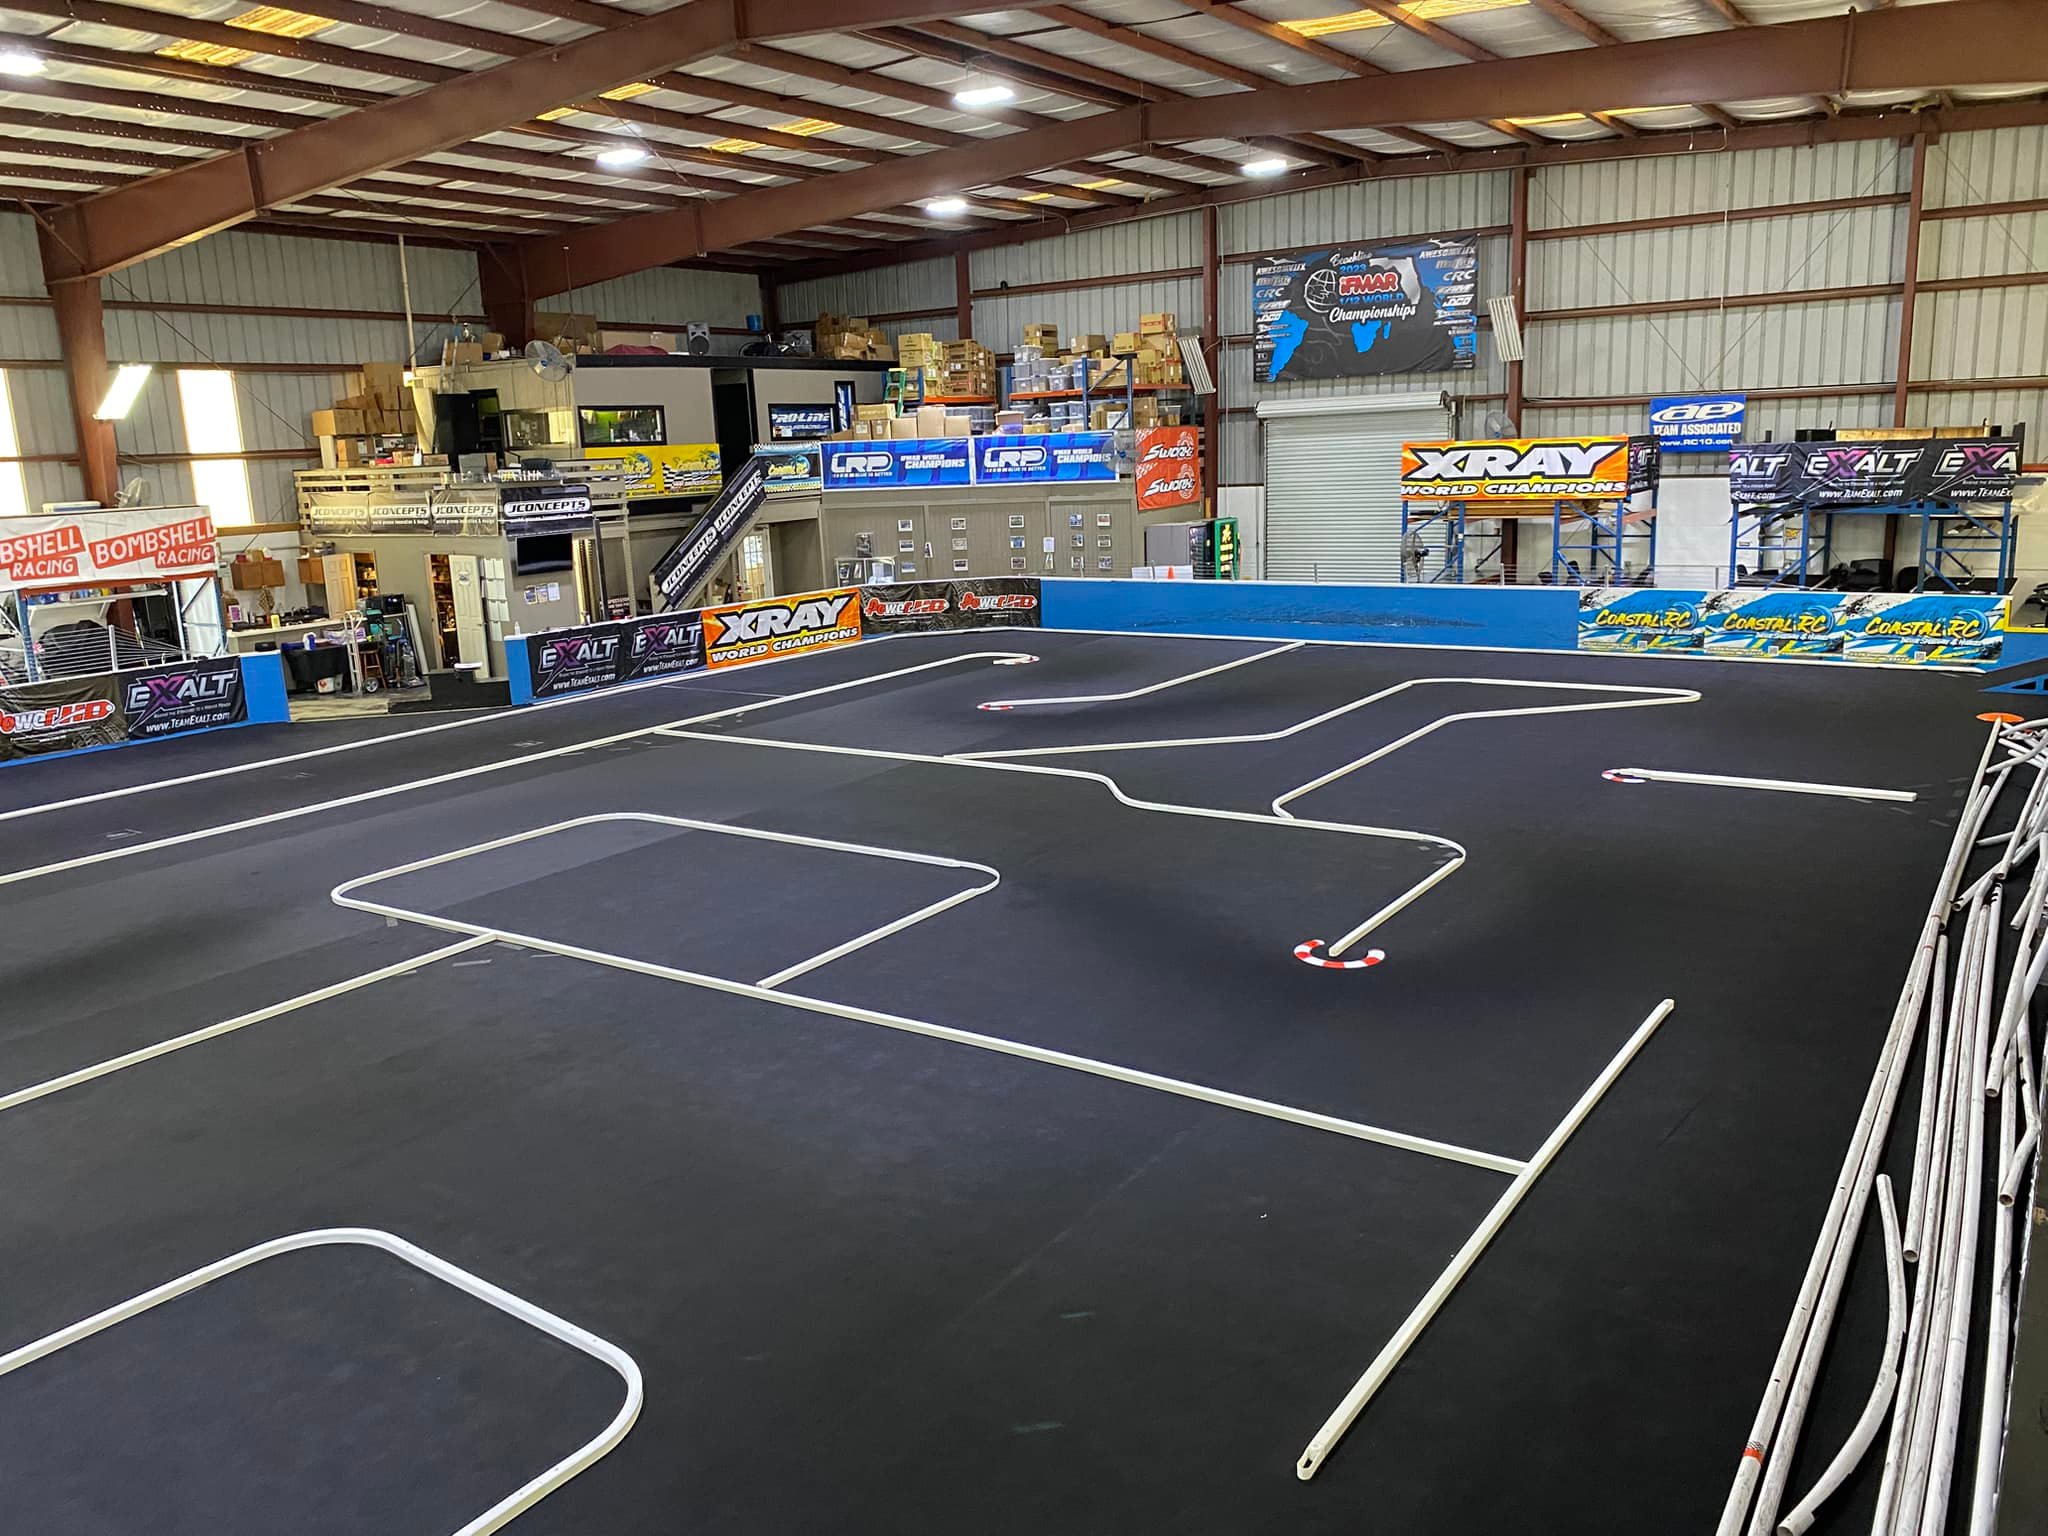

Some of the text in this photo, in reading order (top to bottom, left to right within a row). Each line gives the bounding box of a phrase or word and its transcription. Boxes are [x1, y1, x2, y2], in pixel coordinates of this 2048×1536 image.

[1340, 264, 1367, 273] 2023
[1443, 270, 1476, 281] CRC
[1256, 288, 1285, 298] CRC
[1340, 292, 1405, 305] 1/12 WORLD
[1329, 304, 1416, 323] Championships
[1653, 423, 1741, 435] TEAM ASSOCIATED
[831, 451, 893, 473] LRP
[905, 458, 966, 470] CHAMPIONS
[984, 446, 1047, 468] LRP
[1057, 453, 1111, 464] CHAMPIONS
[1408, 445, 1621, 479] XRAY
[1729, 455, 1787, 476] ALT
[1806, 449, 1919, 479] EXALT
[1400, 485, 1478, 495] WORLD
[1484, 481, 1627, 494] CHAMPIONS
[372, 506, 428, 516] JCONCEPTS
[435, 505, 495, 515] JCONCEPTS
[509, 499, 586, 513] JCONCEPTS
[95, 519, 216, 565] BOMBSHELL
[157, 547, 211, 565] RACING
[666, 531, 714, 587] JCONCEPTS
[12, 559, 74, 577] RACING
[715, 597, 852, 645] XRAY
[1596, 609, 1691, 629] COASTAL RC
[1722, 612, 1827, 634] COASTAL RC
[1864, 616, 1980, 639] COASTAL RC
[636, 624, 702, 650] EXALT
[711, 645, 769, 663] WORLD
[772, 627, 859, 652] CHAMPIONS
[542, 637, 619, 669] EXALT
[128, 671, 234, 709] EXALT
